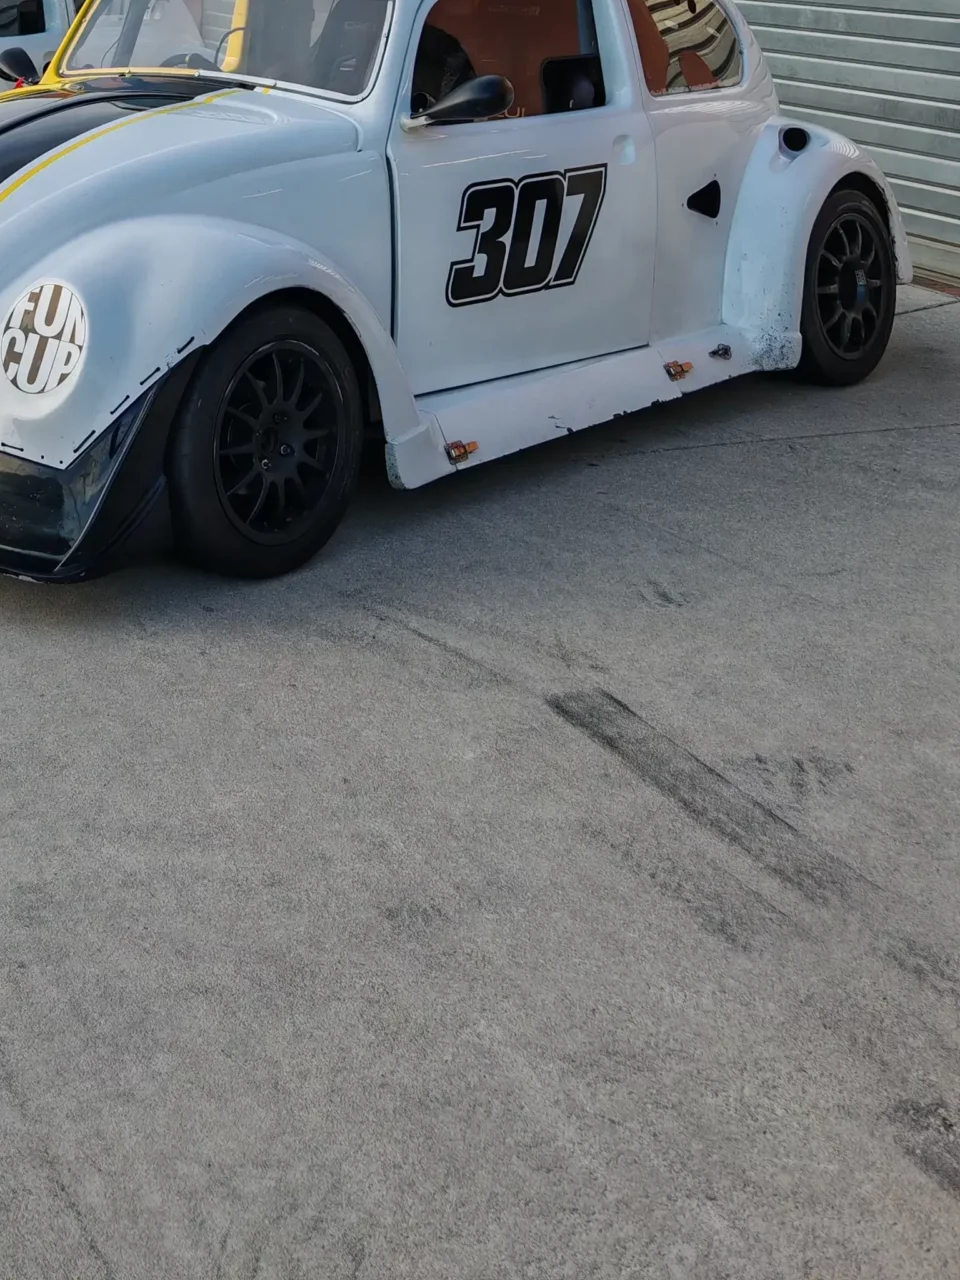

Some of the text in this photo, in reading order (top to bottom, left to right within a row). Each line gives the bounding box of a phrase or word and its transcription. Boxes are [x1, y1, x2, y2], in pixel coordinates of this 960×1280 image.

[445, 163, 608, 308] 307
[8, 284, 85, 347] FUN
[1, 327, 81, 394] CUP
